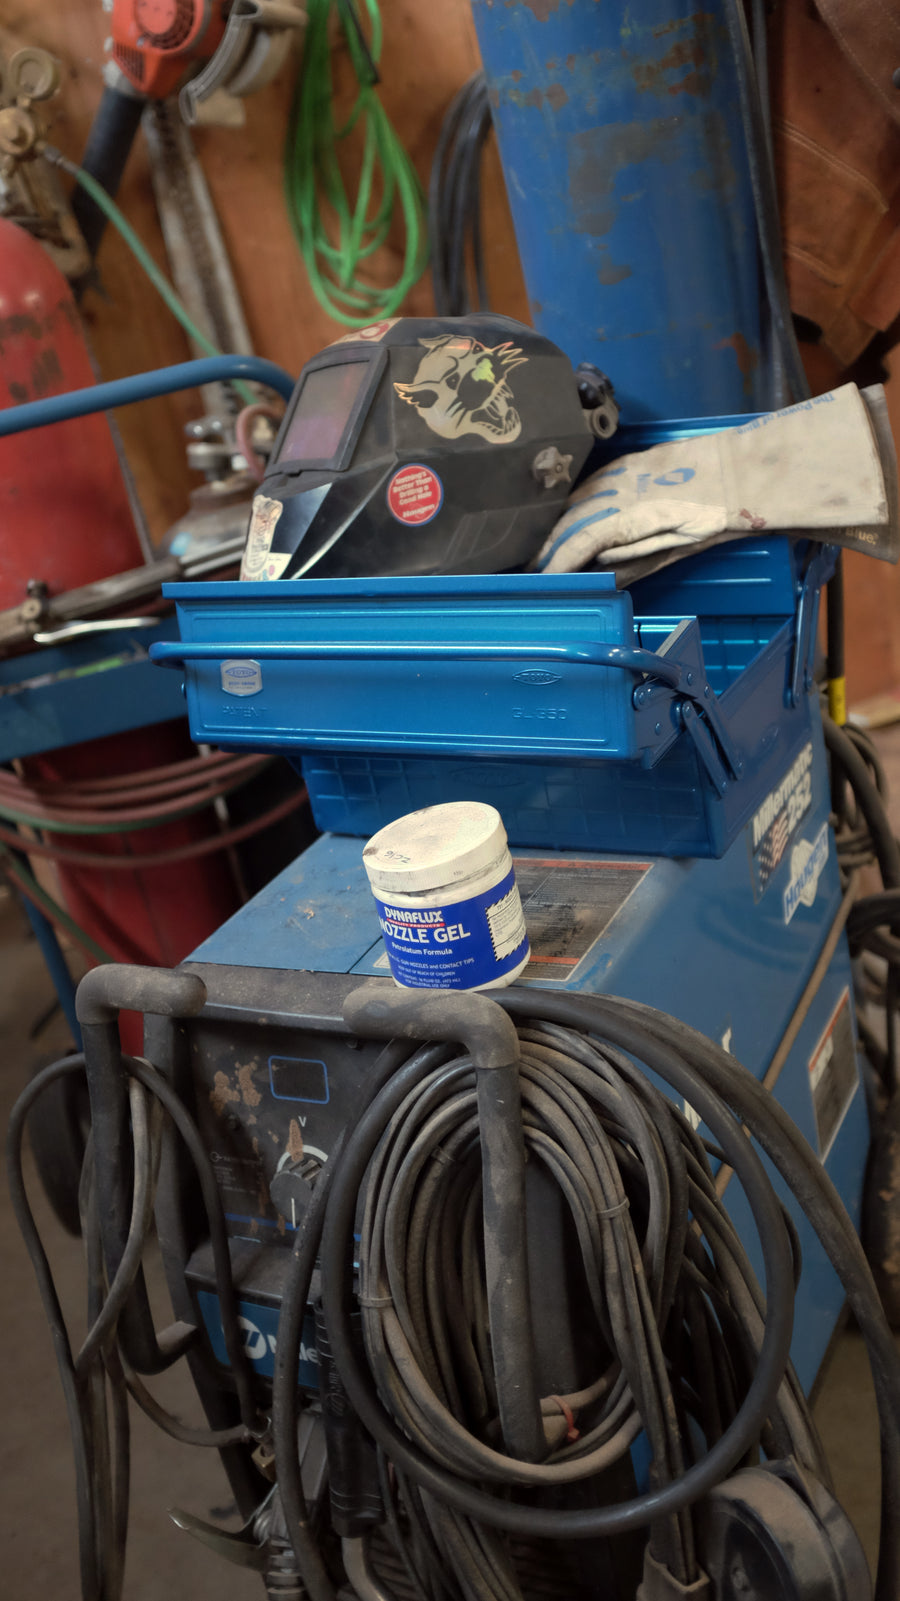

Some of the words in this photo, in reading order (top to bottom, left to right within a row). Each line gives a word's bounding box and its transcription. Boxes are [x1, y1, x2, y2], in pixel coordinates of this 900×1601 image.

[813, 392, 835, 404] The
[777, 401, 813, 418] Power
[762, 414, 774, 425] of
[393, 482, 414, 493] Better
[415, 477, 432, 486] Than
[396, 471, 427, 485] Nothing's
[399, 486, 423, 498] Drilling
[753, 741, 813, 847] Millermatic
[384, 906, 444, 923] DYNAFLUX
[379, 916, 430, 943] NOZZLE
[433, 923, 471, 943] GEL
[391, 941, 422, 955] Petrolatum
[423, 948, 453, 956] Formula
[410, 961, 429, 969] NOZZLES
[439, 961, 463, 969] CONTACT
[463, 957, 475, 965] TIPS
[298, 1115, 307, 1127] V
